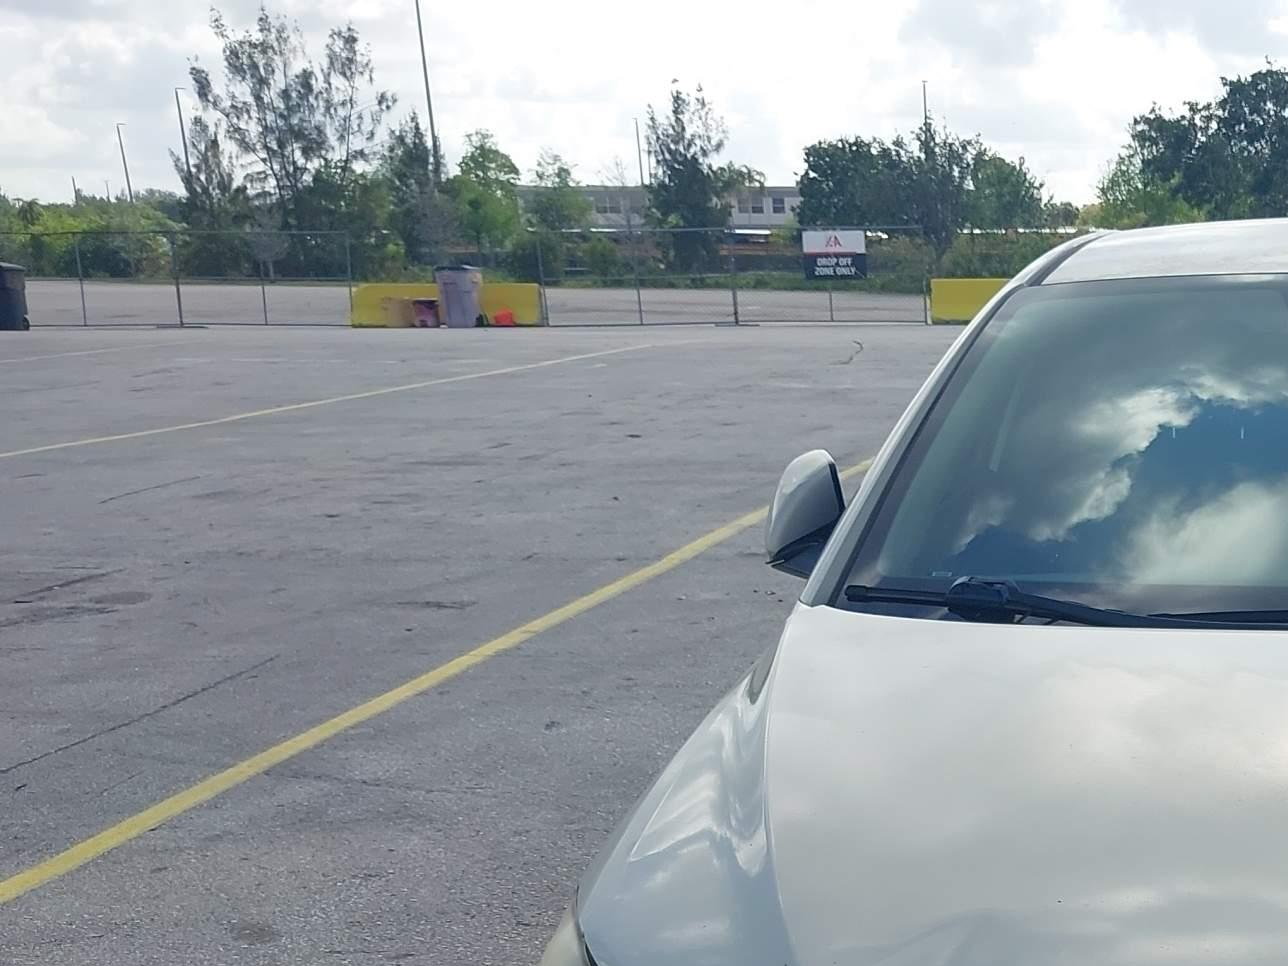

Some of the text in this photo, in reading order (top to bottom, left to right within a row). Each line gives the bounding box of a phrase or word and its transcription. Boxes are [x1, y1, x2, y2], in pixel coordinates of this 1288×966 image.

[816, 257, 853, 266] DROP OFF
[814, 266, 856, 276] ZONE ONLY
